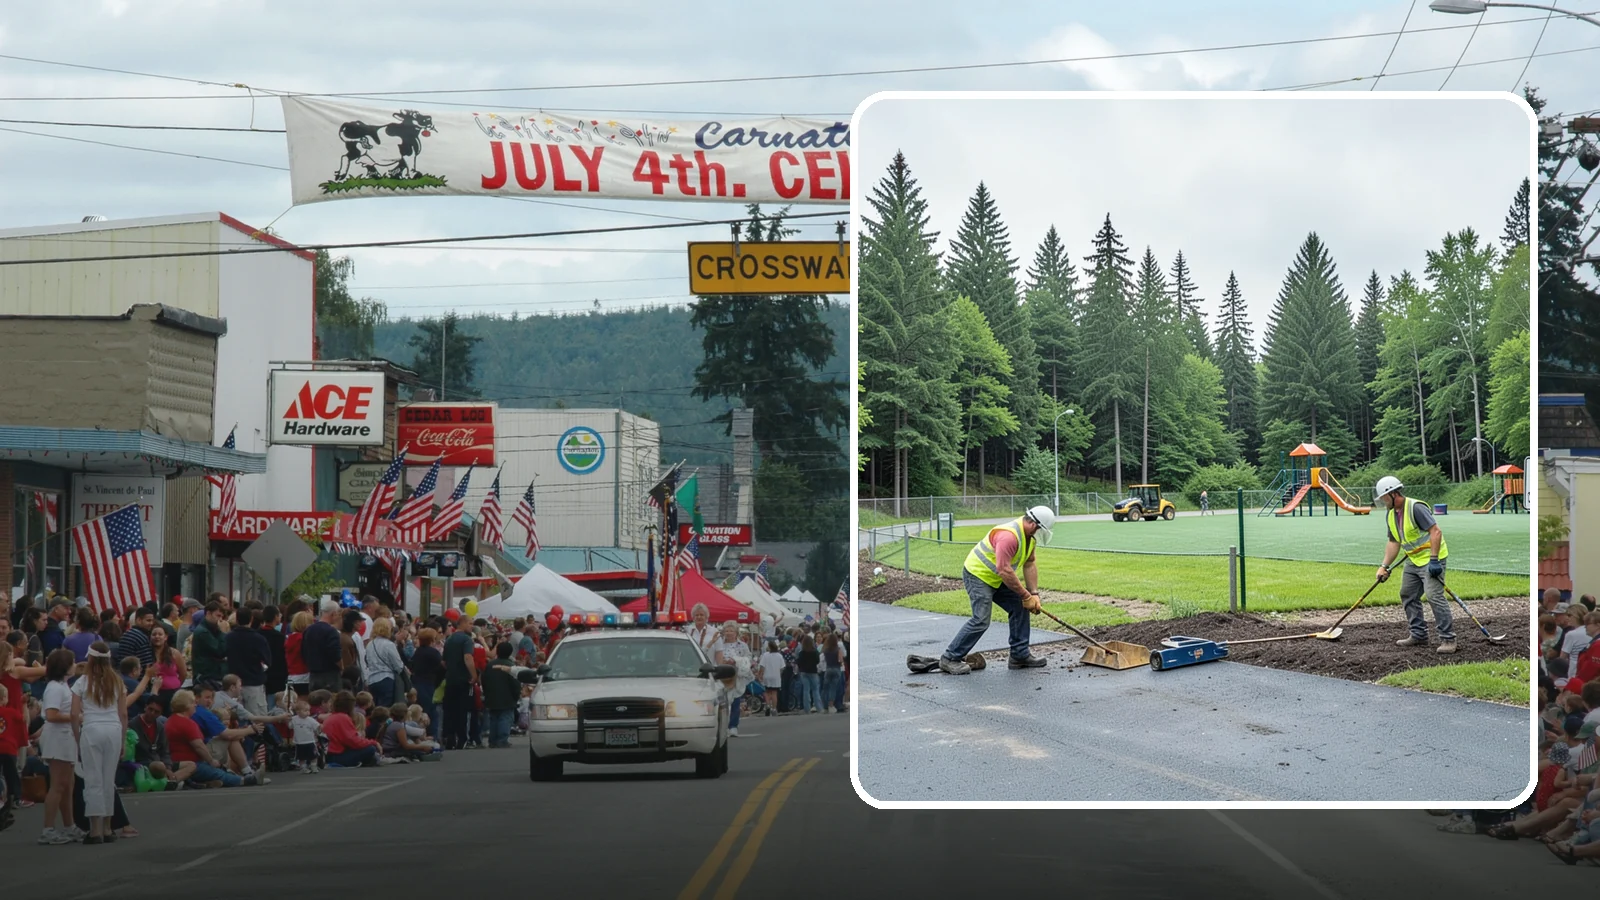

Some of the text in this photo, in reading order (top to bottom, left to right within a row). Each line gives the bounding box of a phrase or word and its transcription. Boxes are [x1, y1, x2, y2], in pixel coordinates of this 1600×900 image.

[481, 141, 605, 192] JULY
[632, 150, 746, 198] 4th.
[697, 254, 850, 280] CROSSWA
[282, 380, 373, 420] ACE
[405, 408, 485, 422] CEDAR LOG
[283, 421, 371, 436] Hardware
[416, 428, 477, 447] Coca-Cola
[353, 467, 384, 479] Simpl
[83, 485, 155, 495] St. Vincent de Paul
[688, 526, 741, 535] CRNATION
[699, 535, 730, 543] GLASS
